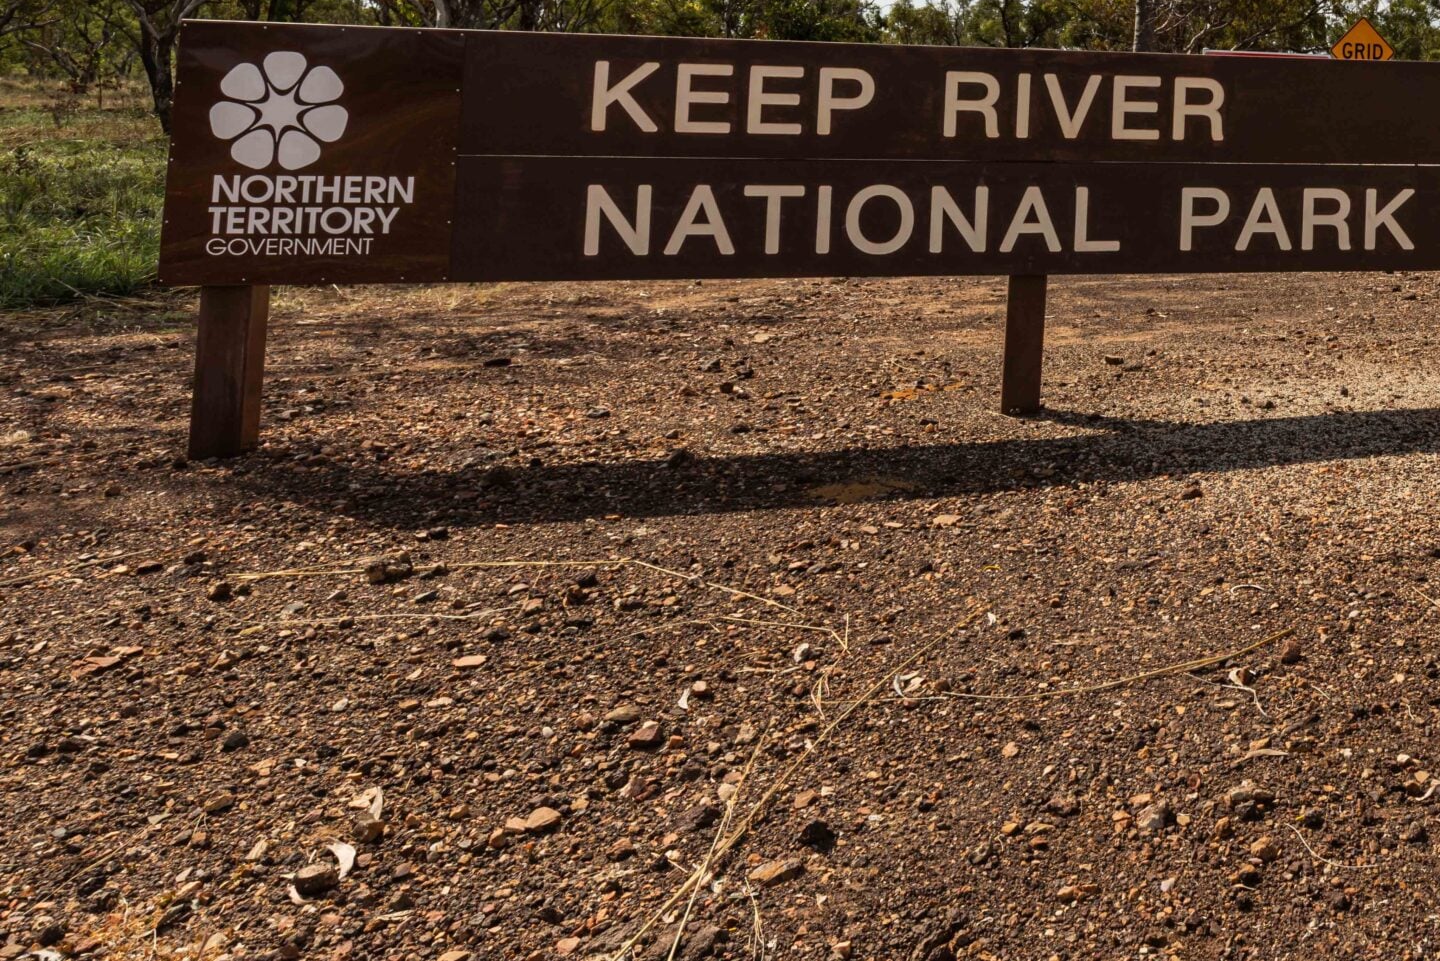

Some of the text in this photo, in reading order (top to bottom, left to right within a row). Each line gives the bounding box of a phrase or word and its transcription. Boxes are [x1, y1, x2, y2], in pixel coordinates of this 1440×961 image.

[1342, 43, 1383, 60] GRID
[591, 60, 1226, 141] KEEP RIVER
[211, 174, 415, 204] NORTHERN
[207, 206, 401, 235] TERRITORY
[583, 184, 1416, 257] NATIONAL PARK
[205, 237, 374, 256] GOVERNMENT
